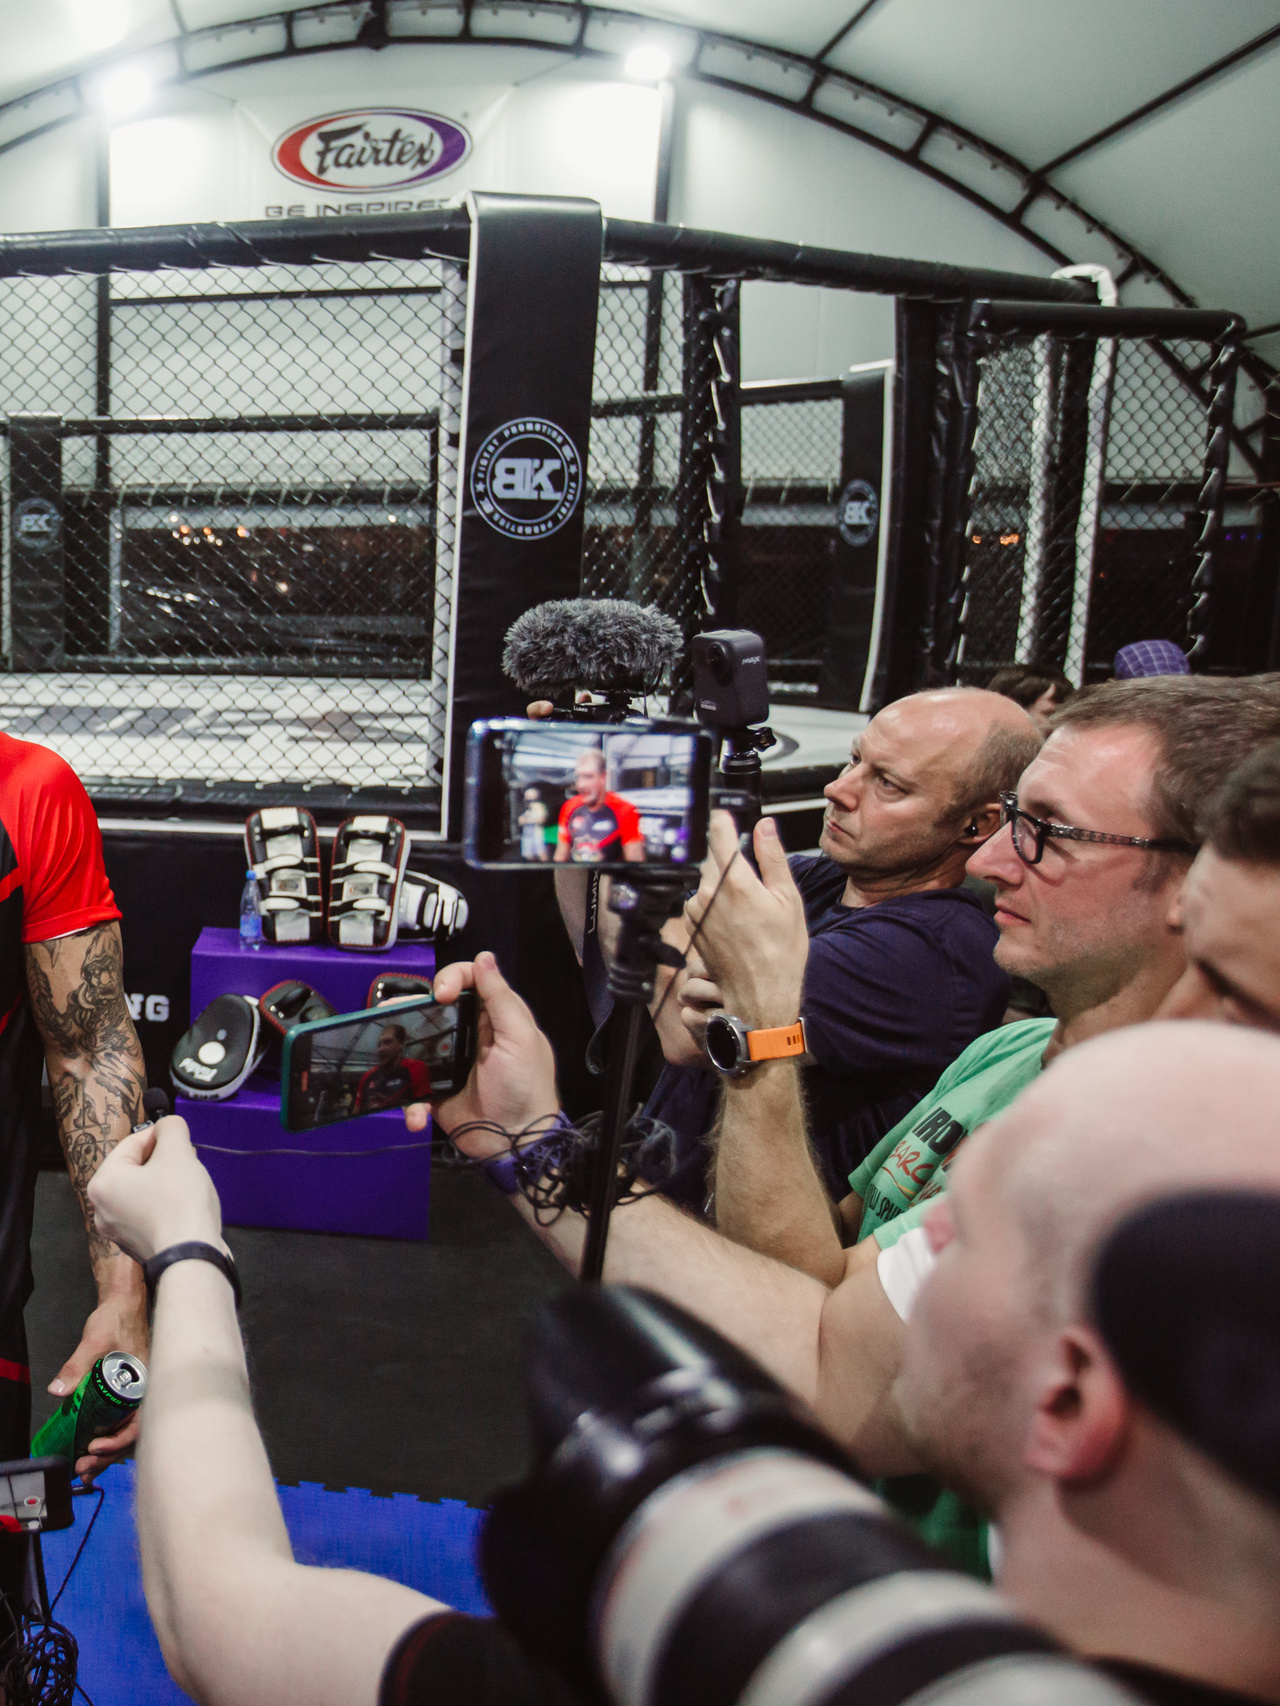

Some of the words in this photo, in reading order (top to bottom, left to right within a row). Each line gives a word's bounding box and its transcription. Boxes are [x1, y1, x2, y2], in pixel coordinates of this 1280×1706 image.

[315, 122, 435, 176] Fairtex
[265, 204, 305, 218] BE
[317, 199, 446, 217] INSPIRE
[492, 457, 562, 500] BK
[912, 1107, 969, 1155] IRO
